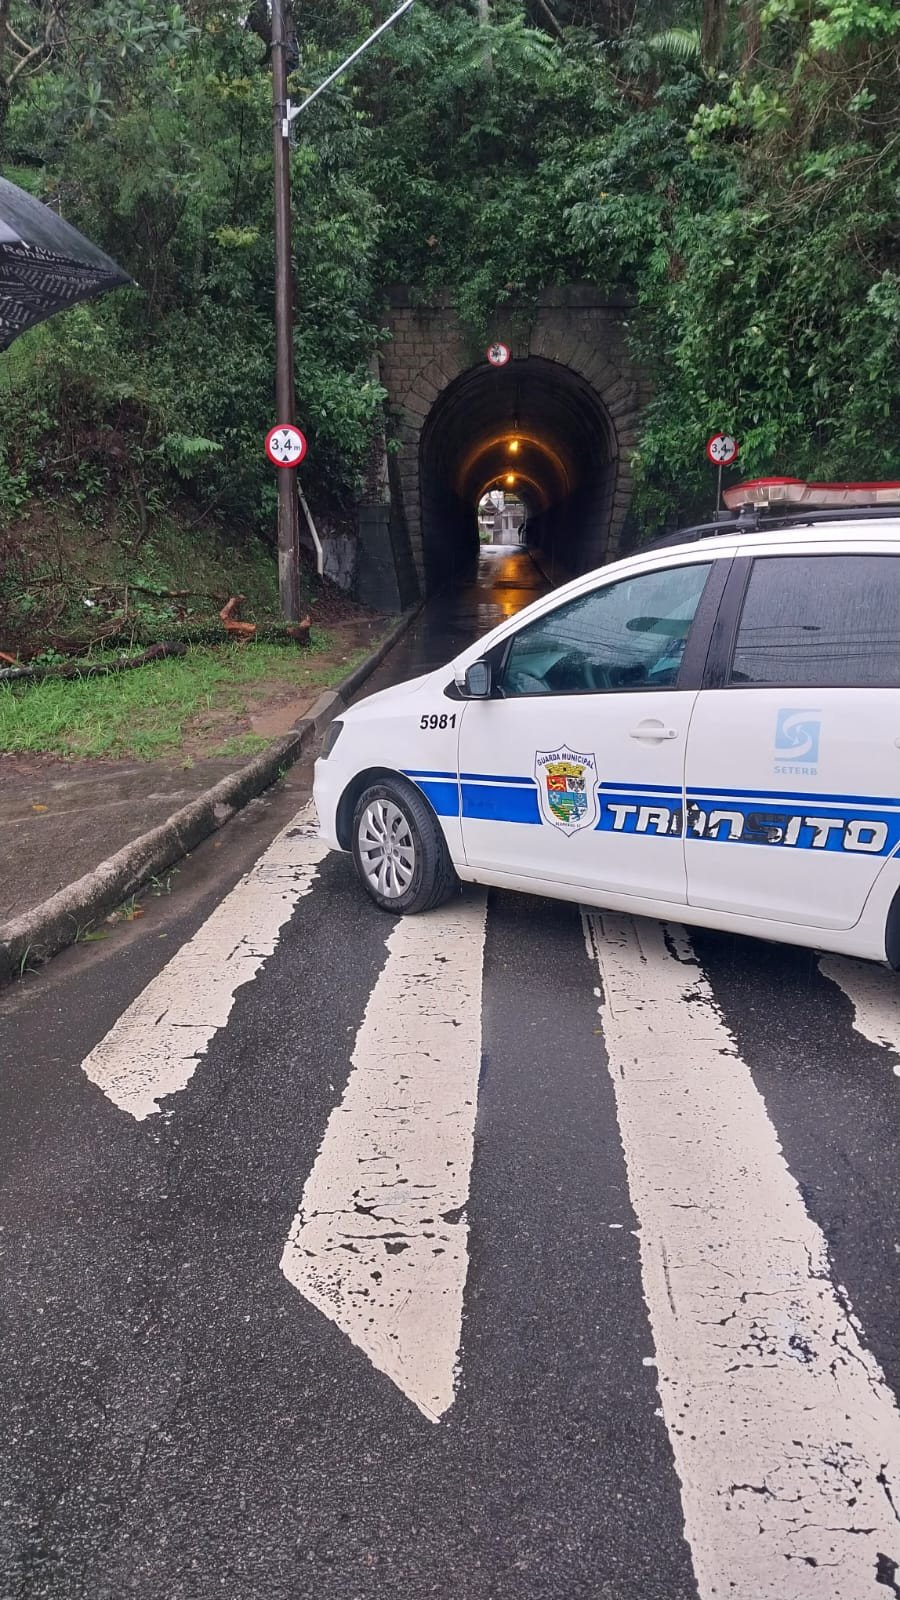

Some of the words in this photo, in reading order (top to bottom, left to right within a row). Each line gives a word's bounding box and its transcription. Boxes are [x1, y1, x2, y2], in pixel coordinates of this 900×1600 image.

[420, 713, 456, 730] 5981
[538, 753, 560, 766] GUARDA
[562, 753, 593, 769] MUNICIPAL
[773, 765, 818, 776] SETERB
